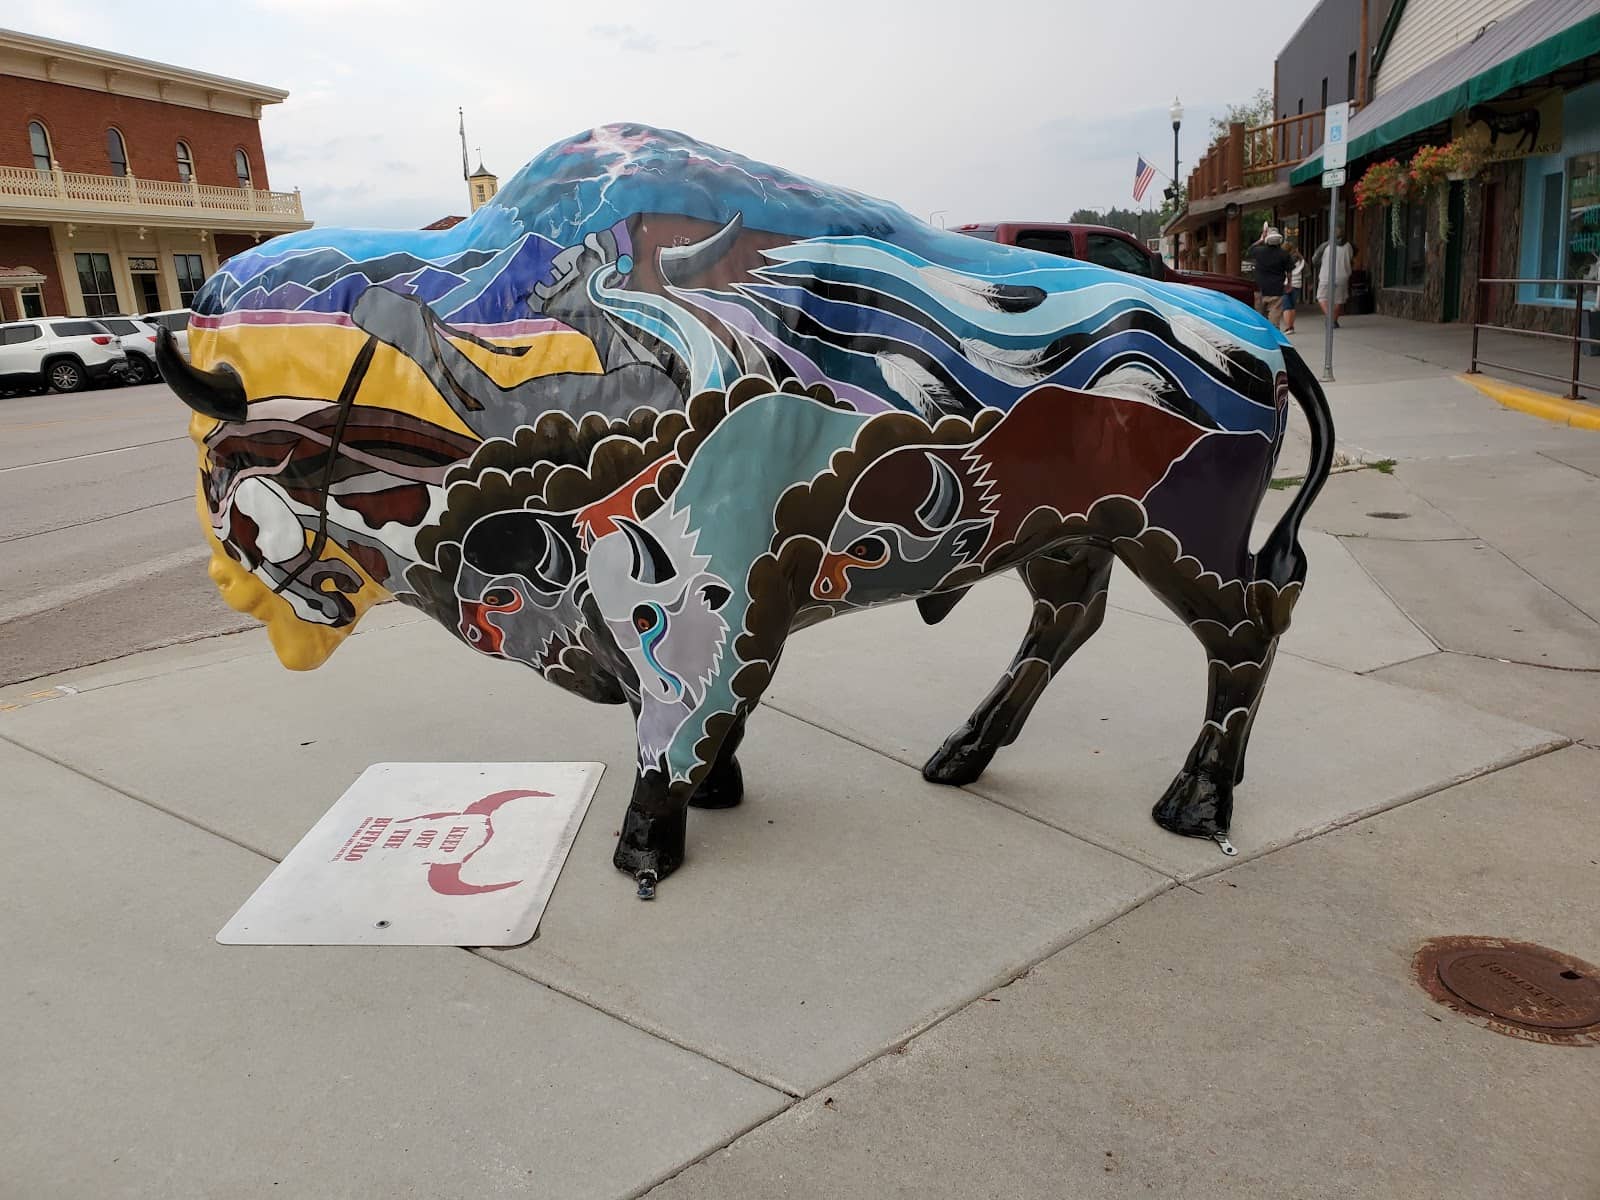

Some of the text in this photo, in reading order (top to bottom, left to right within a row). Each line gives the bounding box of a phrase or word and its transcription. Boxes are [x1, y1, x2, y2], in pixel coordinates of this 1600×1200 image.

[344, 817, 393, 861] BUFFALO
[382, 829, 412, 848] THE
[412, 830, 438, 848] OFF
[438, 826, 468, 852] KEEP
